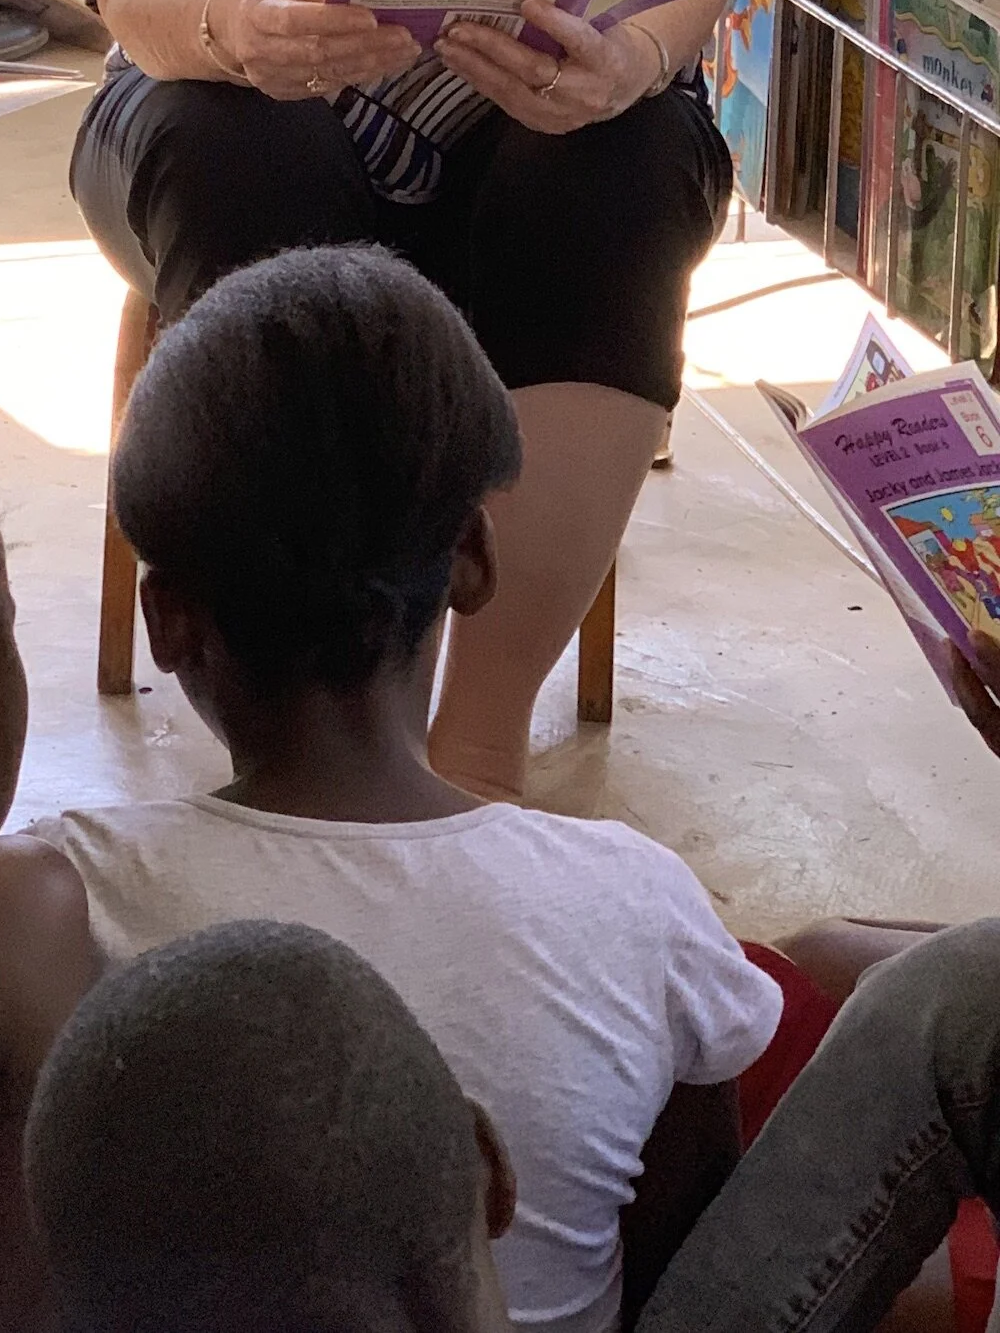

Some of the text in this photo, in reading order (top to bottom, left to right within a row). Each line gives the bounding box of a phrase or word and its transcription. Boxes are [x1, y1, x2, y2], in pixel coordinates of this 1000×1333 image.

[834, 414, 949, 456] Happy Readers
[975, 425, 993, 448] 6
[909, 471, 937, 489] and
